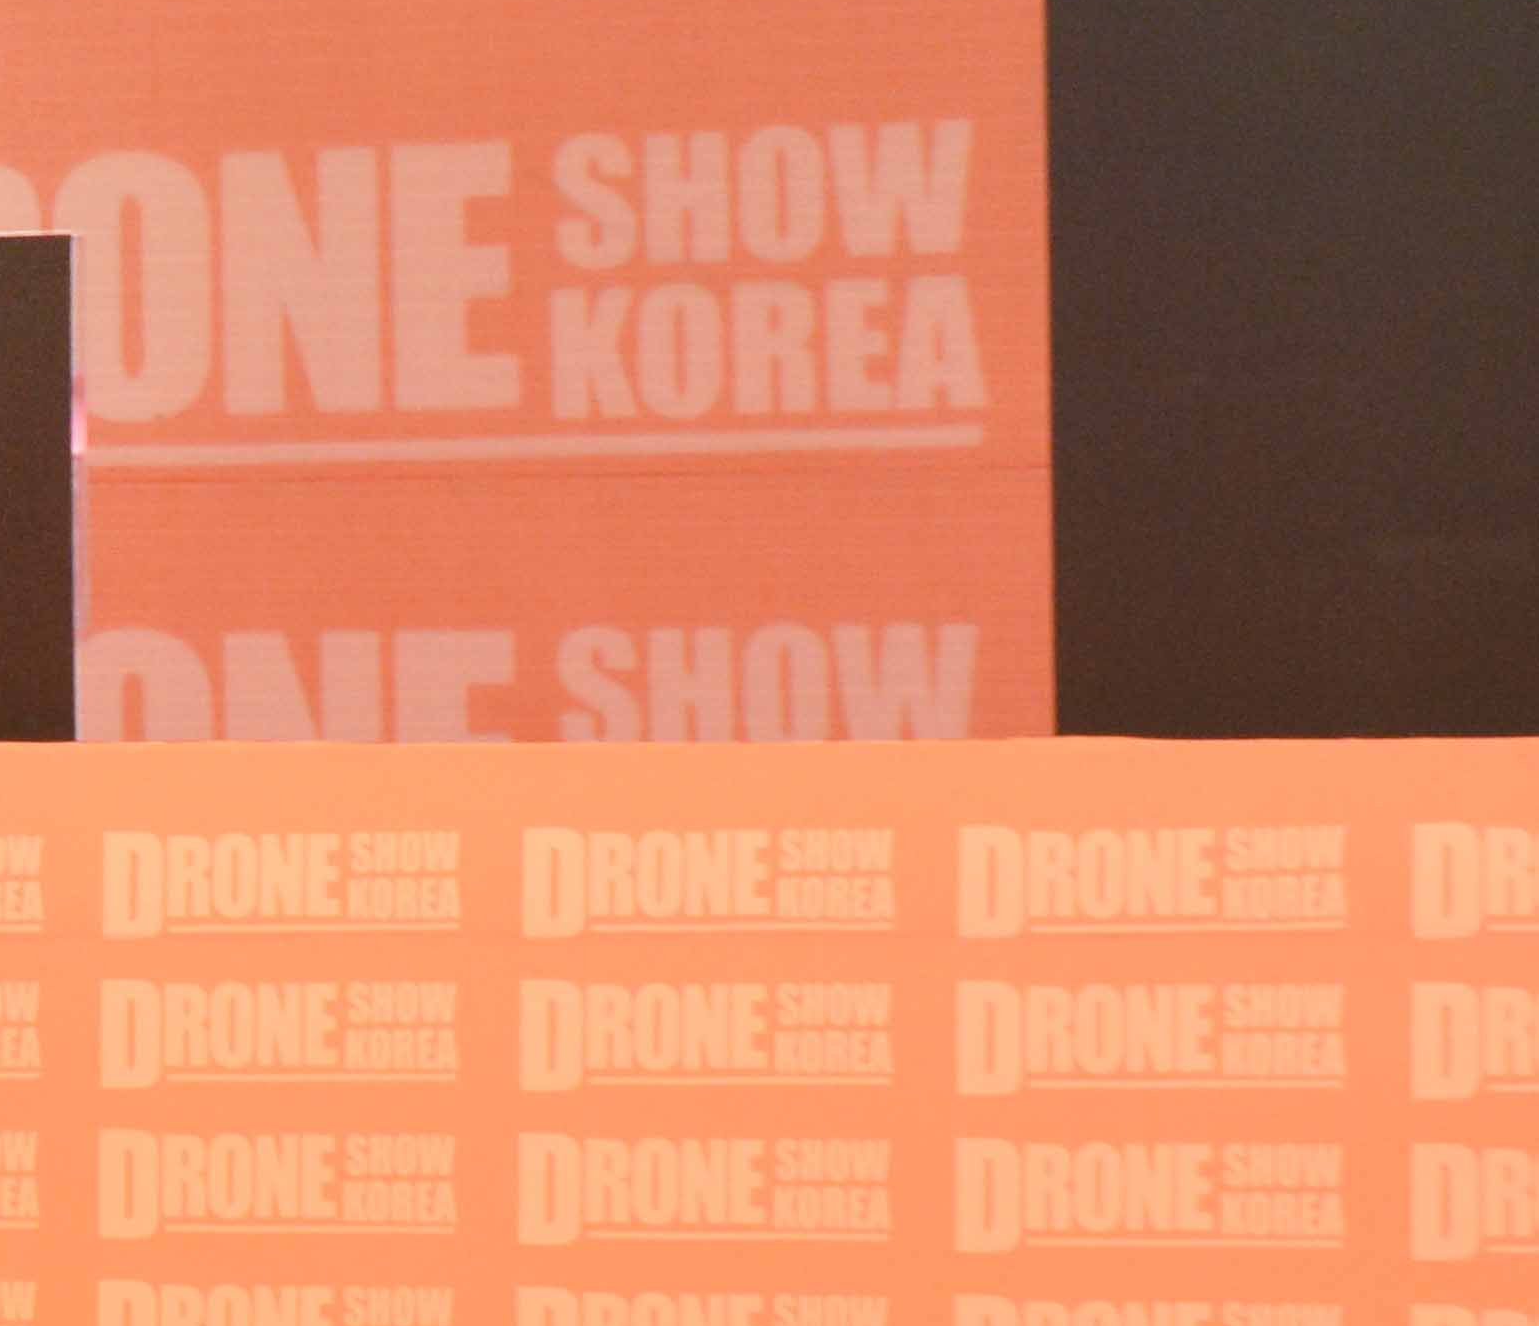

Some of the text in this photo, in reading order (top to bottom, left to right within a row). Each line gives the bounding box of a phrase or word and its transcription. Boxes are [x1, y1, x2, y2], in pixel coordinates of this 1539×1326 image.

[552, 117, 973, 271] SHOW
[550, 273, 990, 420] KOREA
[103, 830, 460, 939] DRONE SHOW
[348, 877, 461, 921] KOREA
[522, 826, 893, 938] DRONE SHOW
[778, 876, 894, 921] KOREA
[958, 825, 1344, 938] DRONE SHOW
[1223, 875, 1346, 919] KOREA
[100, 978, 458, 1089] DRONE SHOW
[346, 1028, 458, 1072] KOREA
[520, 979, 892, 1092] DRONE SHOW
[776, 1032, 892, 1075] KOREA
[956, 980, 1343, 1095] DRONE SHOW
[1222, 1032, 1345, 1076] KOREA
[98, 1128, 455, 1239] DRONE SHOW
[344, 1180, 456, 1223] KOREA
[518, 1132, 890, 1245] DRONE SHOW
[773, 1187, 891, 1231] KOREA
[956, 1137, 1343, 1253] DRONE SHOW
[1221, 1192, 1343, 1235] KOREA
